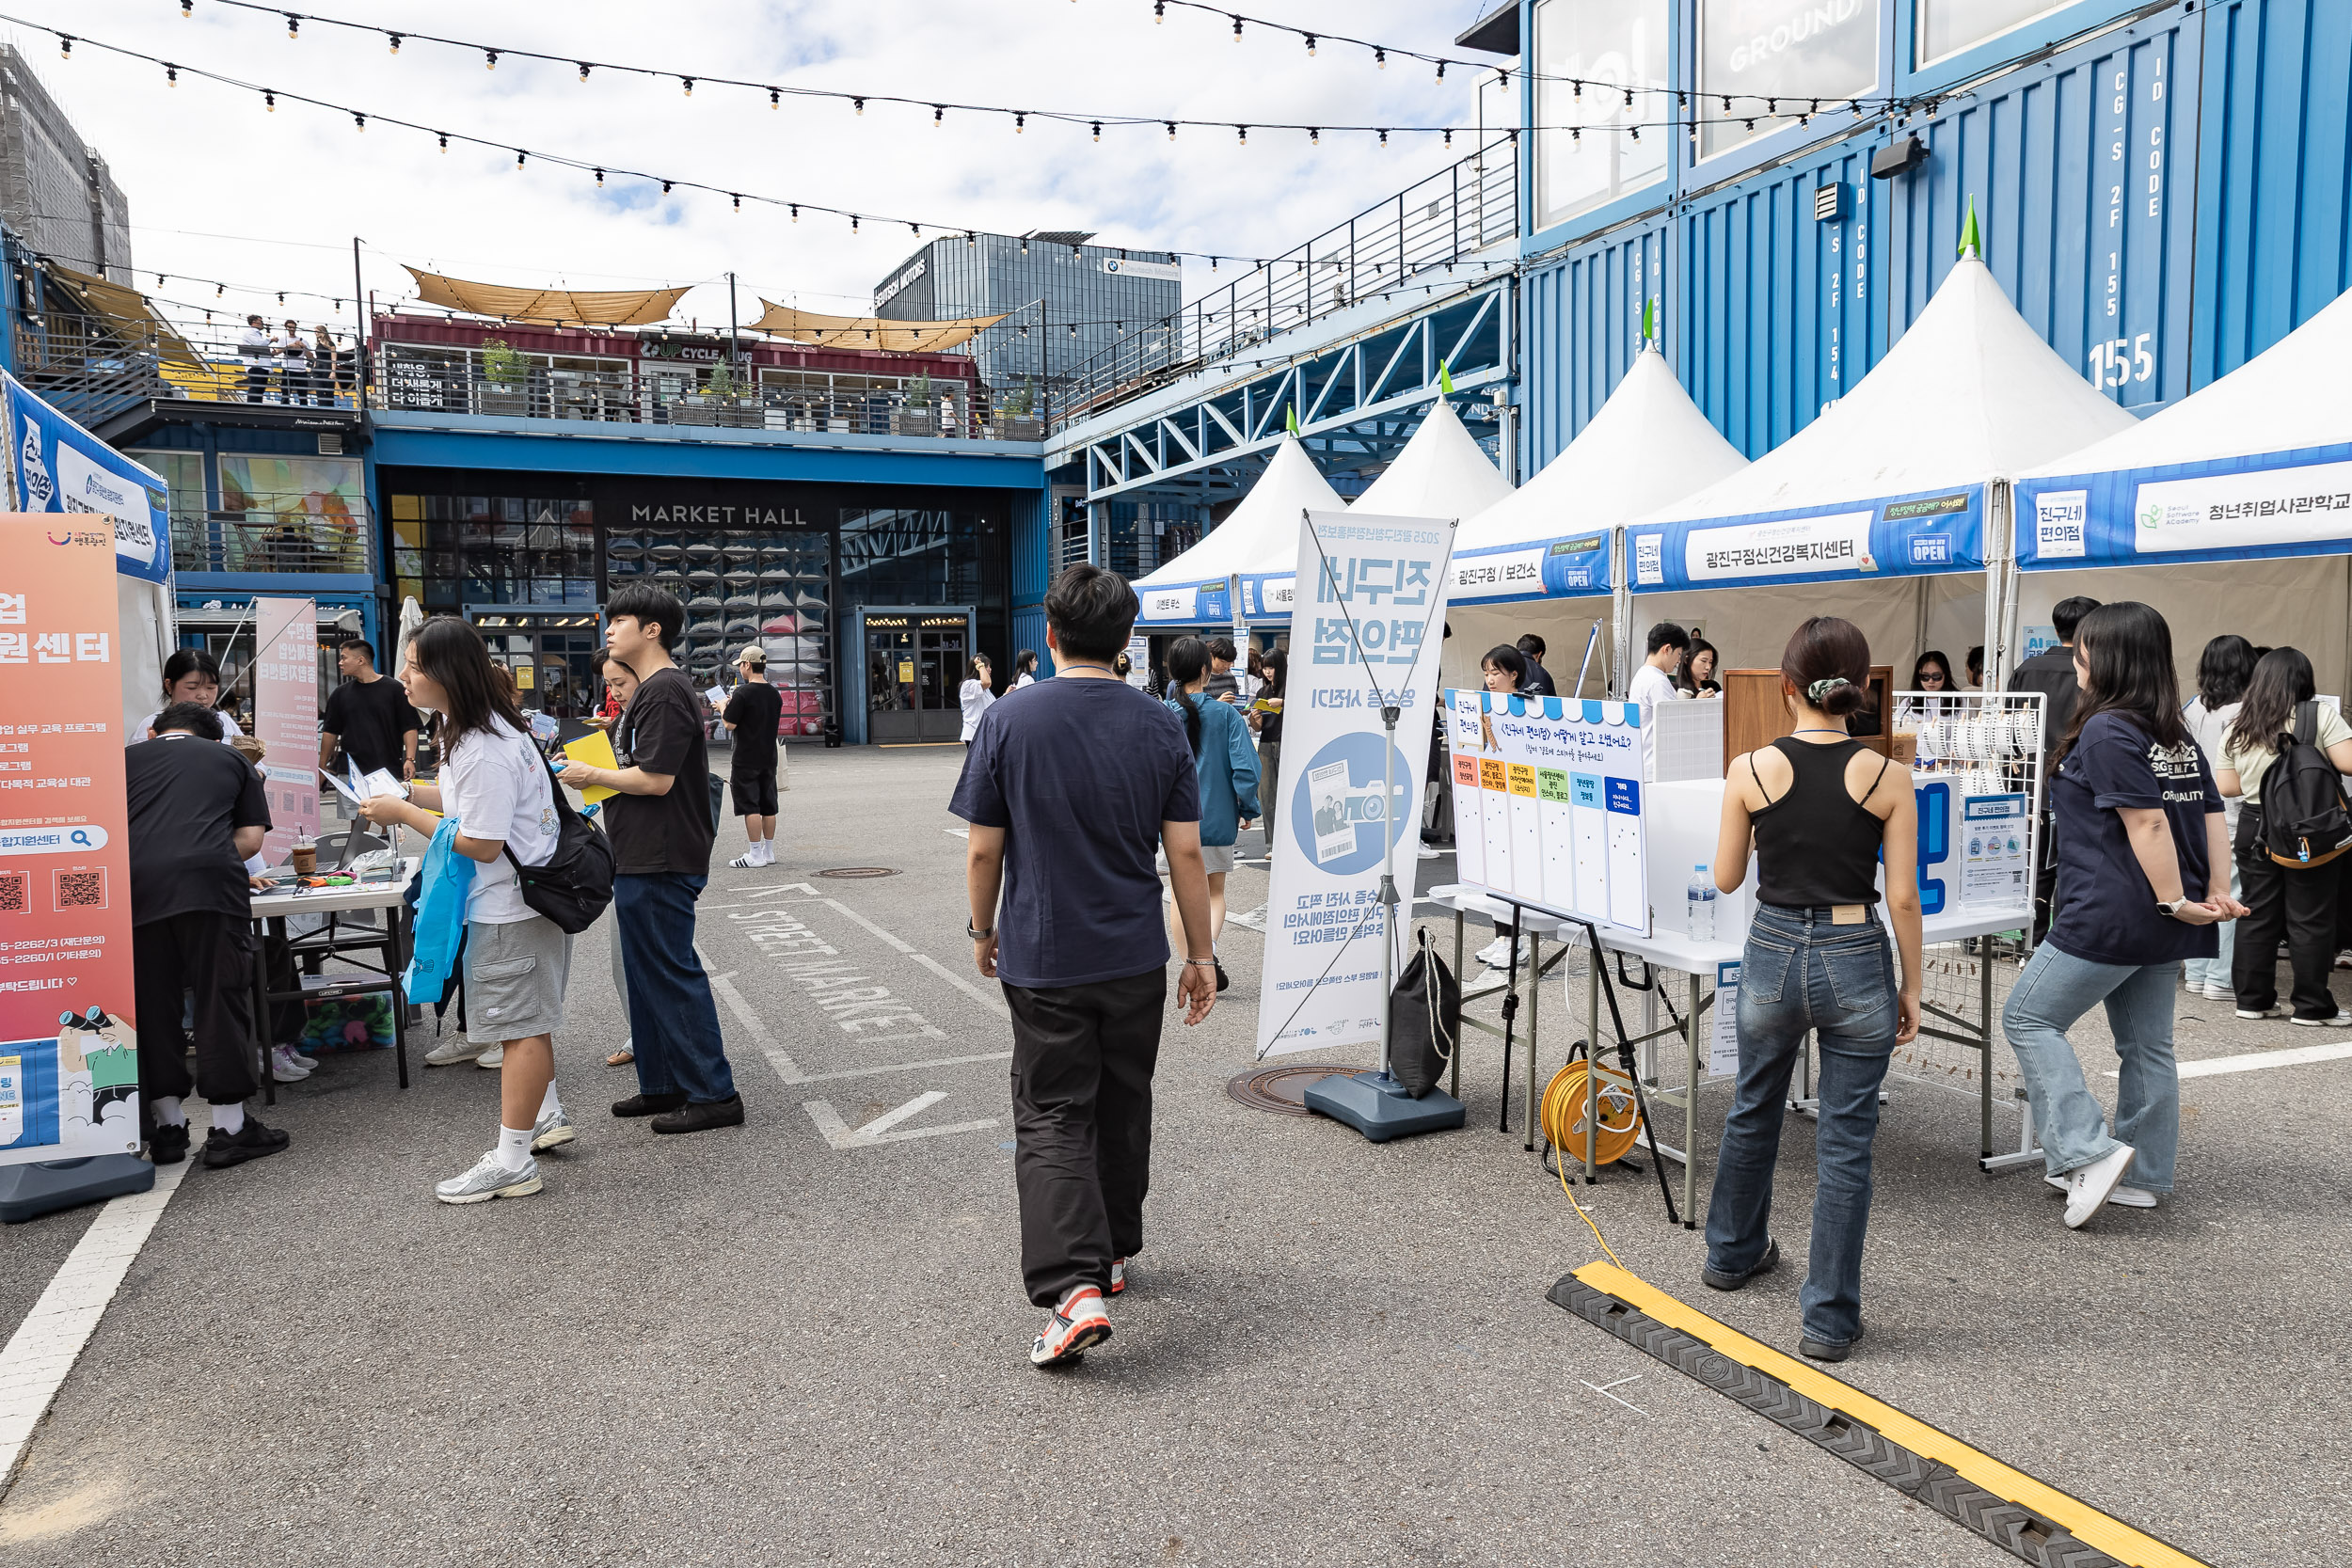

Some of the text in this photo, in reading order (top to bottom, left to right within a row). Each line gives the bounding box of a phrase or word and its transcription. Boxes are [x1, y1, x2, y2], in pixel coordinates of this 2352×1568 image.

[2106, 252, 2117, 317] 155
[1830, 327, 1838, 380] 154
[2089, 333, 2153, 391] 155
[2040, 505, 2082, 522] 진구네
[2209, 493, 2351, 520] 청년취업사관학교
[632, 505, 807, 526] MARKET HALL
[2041, 525, 2081, 542] 편의점
[1706, 539, 1854, 569] 광진구정신건강복지센터
[1914, 546, 1947, 561] OPEN
[1459, 566, 1496, 585] 광진구청
[1506, 562, 1536, 580] 보건소
[1567, 576, 1588, 587] OPEN
[1276, 589, 1295, 602] 서울청
[2028, 637, 2043, 649] AI
[1458, 701, 1477, 714] 진구네
[17, 723, 39, 735] 실무
[40, 723, 62, 734] 교육
[64, 722, 106, 733] 프로그램
[1460, 719, 1478, 735] 편의점
[1579, 730, 1596, 746] 알고
[36, 778, 68, 788] 교육실
[70, 777, 91, 787] 대관
[0, 834, 60, 847] 합지원센터
[60, 935, 105, 947] (재단문의)
[726, 910, 839, 957] STREET
[56, 949, 102, 961] (기타문의)
